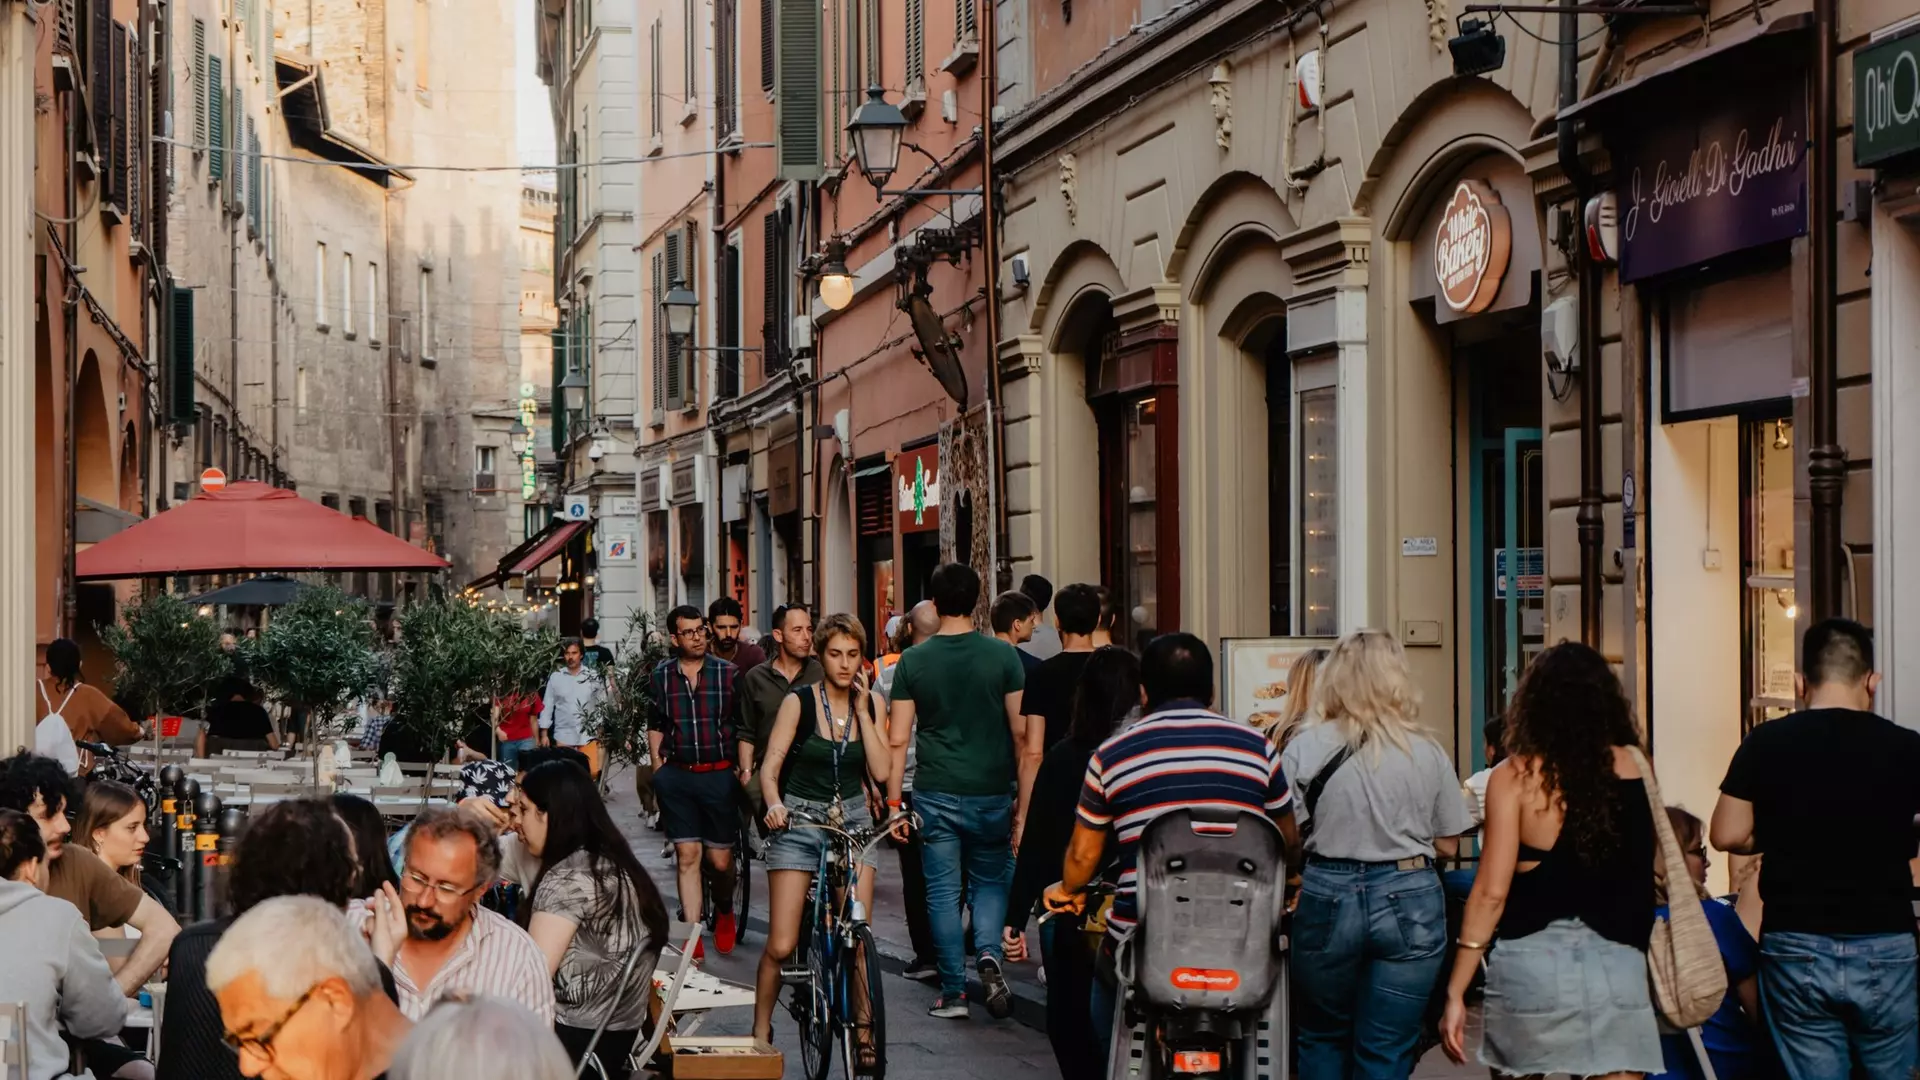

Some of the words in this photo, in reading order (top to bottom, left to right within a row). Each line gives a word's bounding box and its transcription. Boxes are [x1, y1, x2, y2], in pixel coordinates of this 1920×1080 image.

[1650, 148, 1703, 223] Gioielli
[1706, 141, 1728, 197] Di
[1438, 224, 1485, 280] Bakery
[1447, 204, 1478, 245] White
